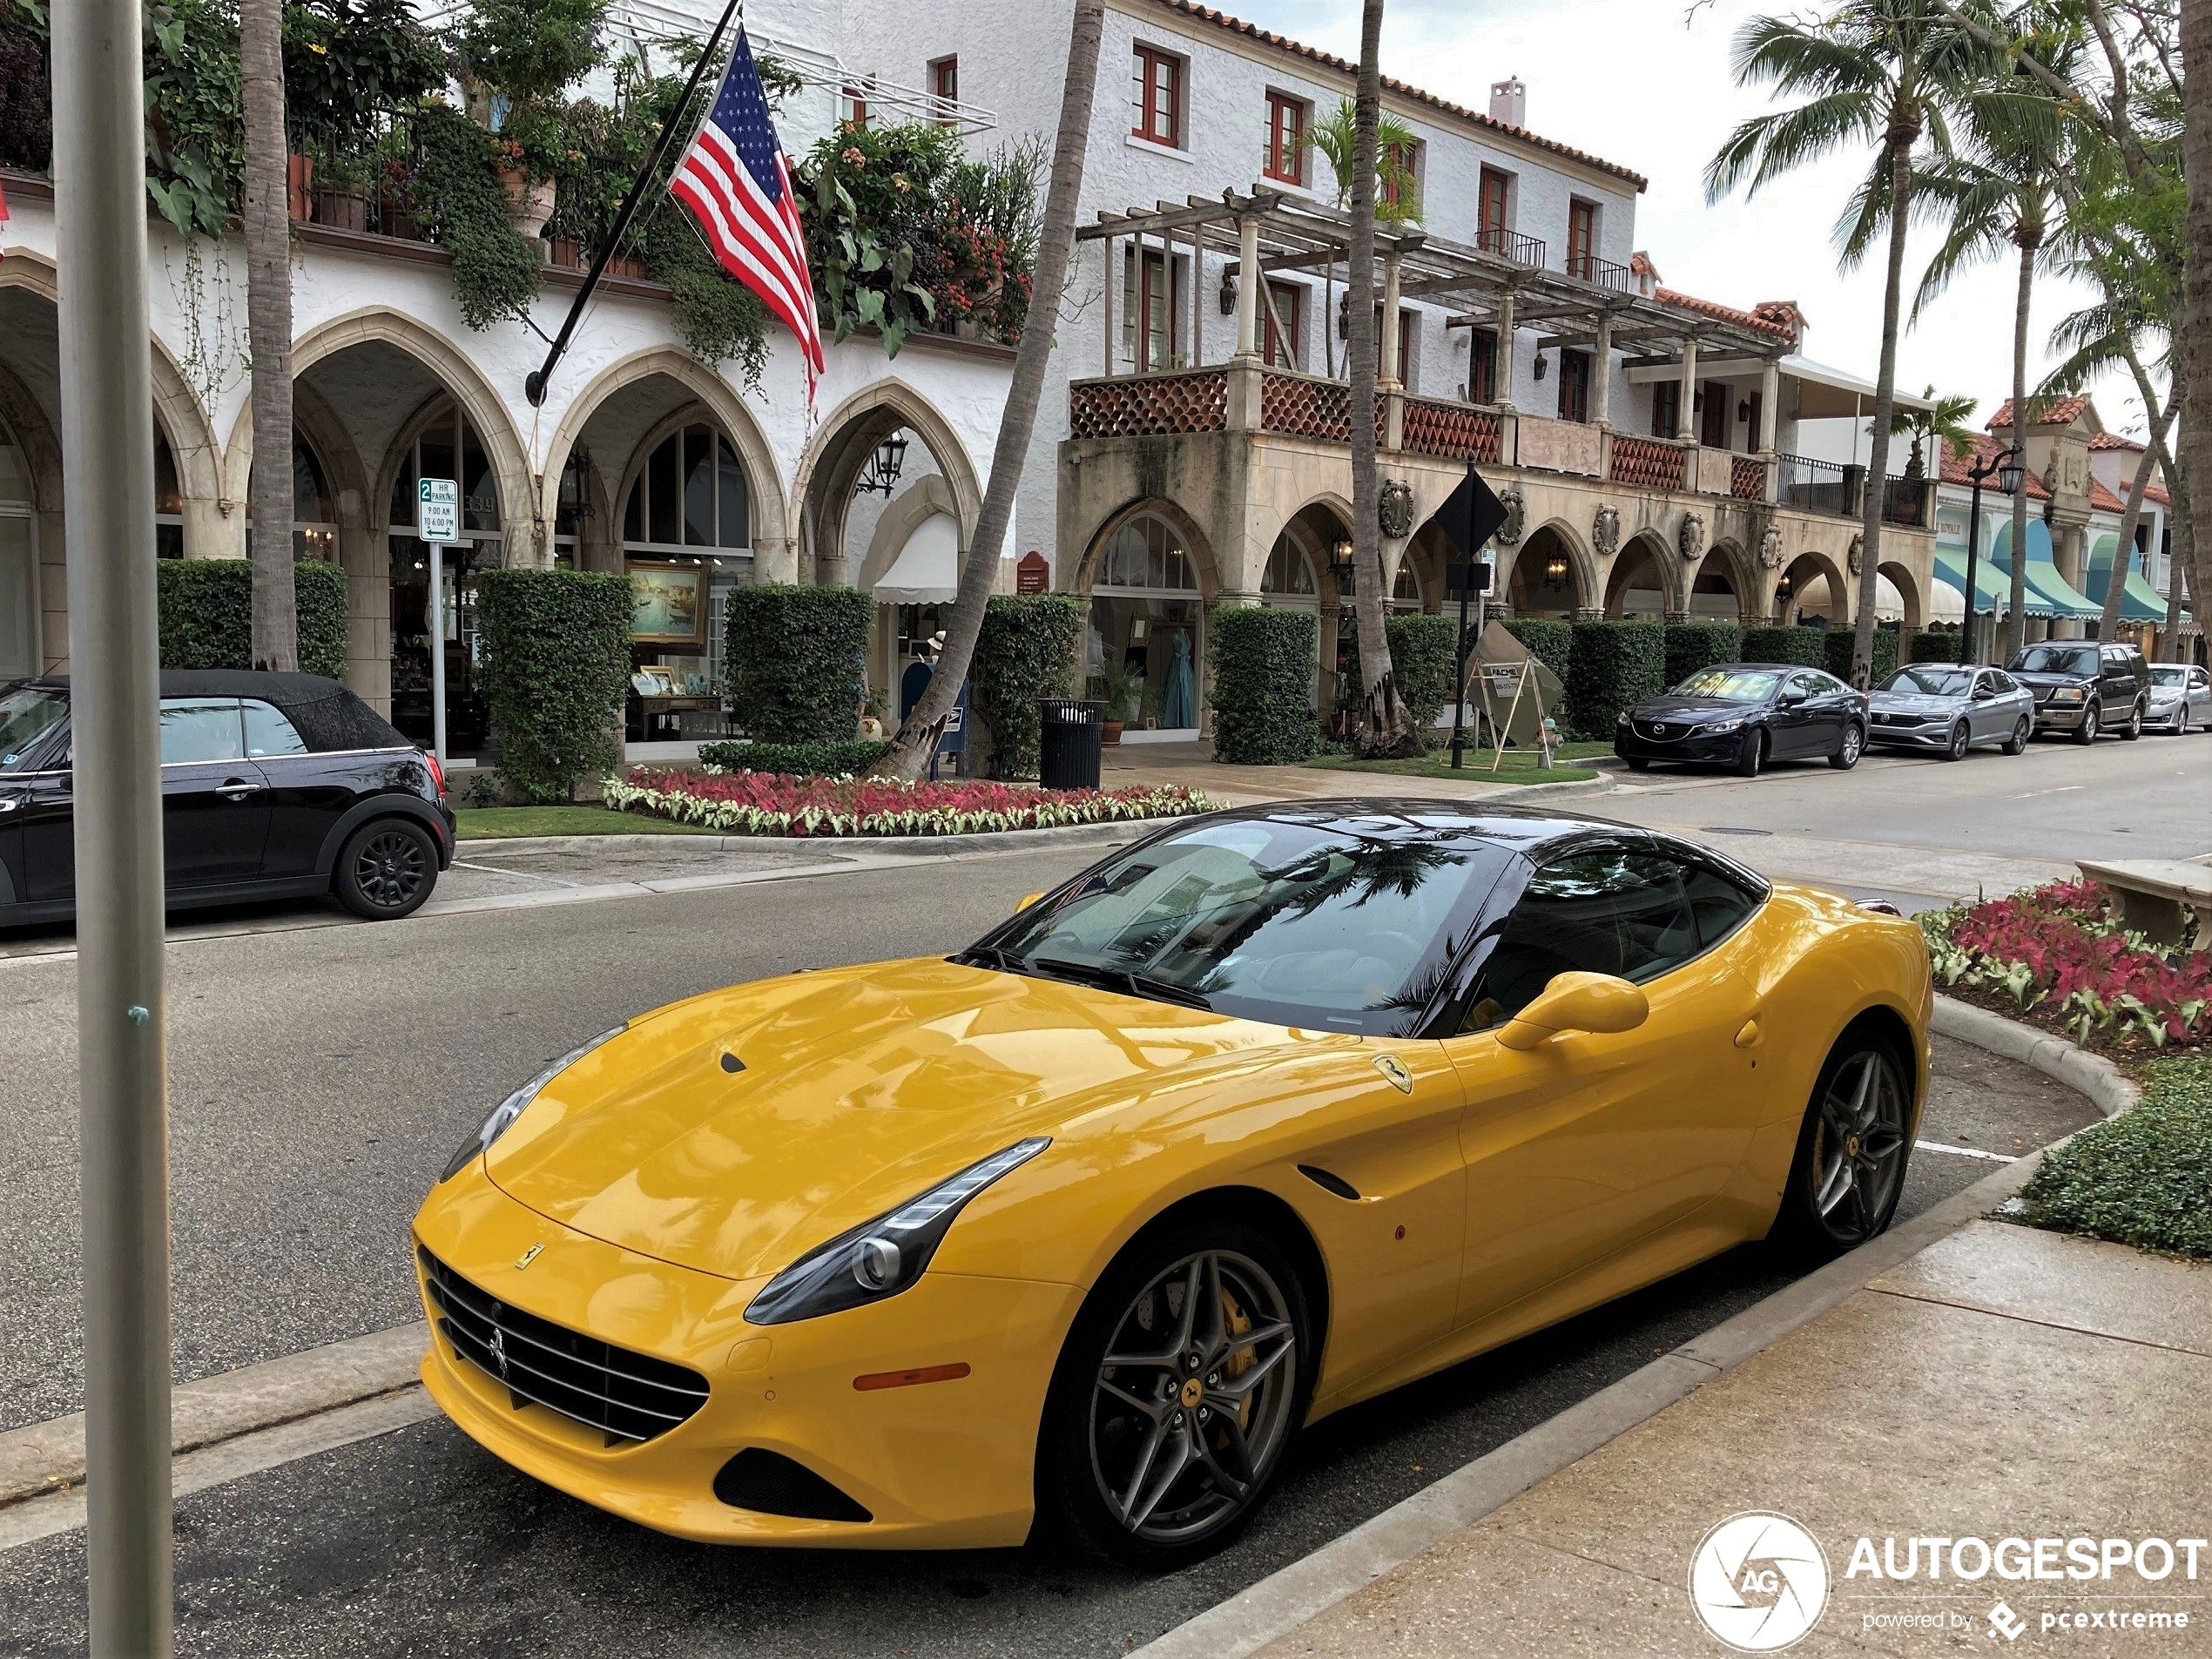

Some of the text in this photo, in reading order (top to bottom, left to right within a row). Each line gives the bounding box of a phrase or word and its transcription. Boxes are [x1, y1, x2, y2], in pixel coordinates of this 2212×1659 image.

[421, 483, 449, 500] 2 HR
[432, 492, 455, 502] PARKING
[442, 507, 450, 516] AM
